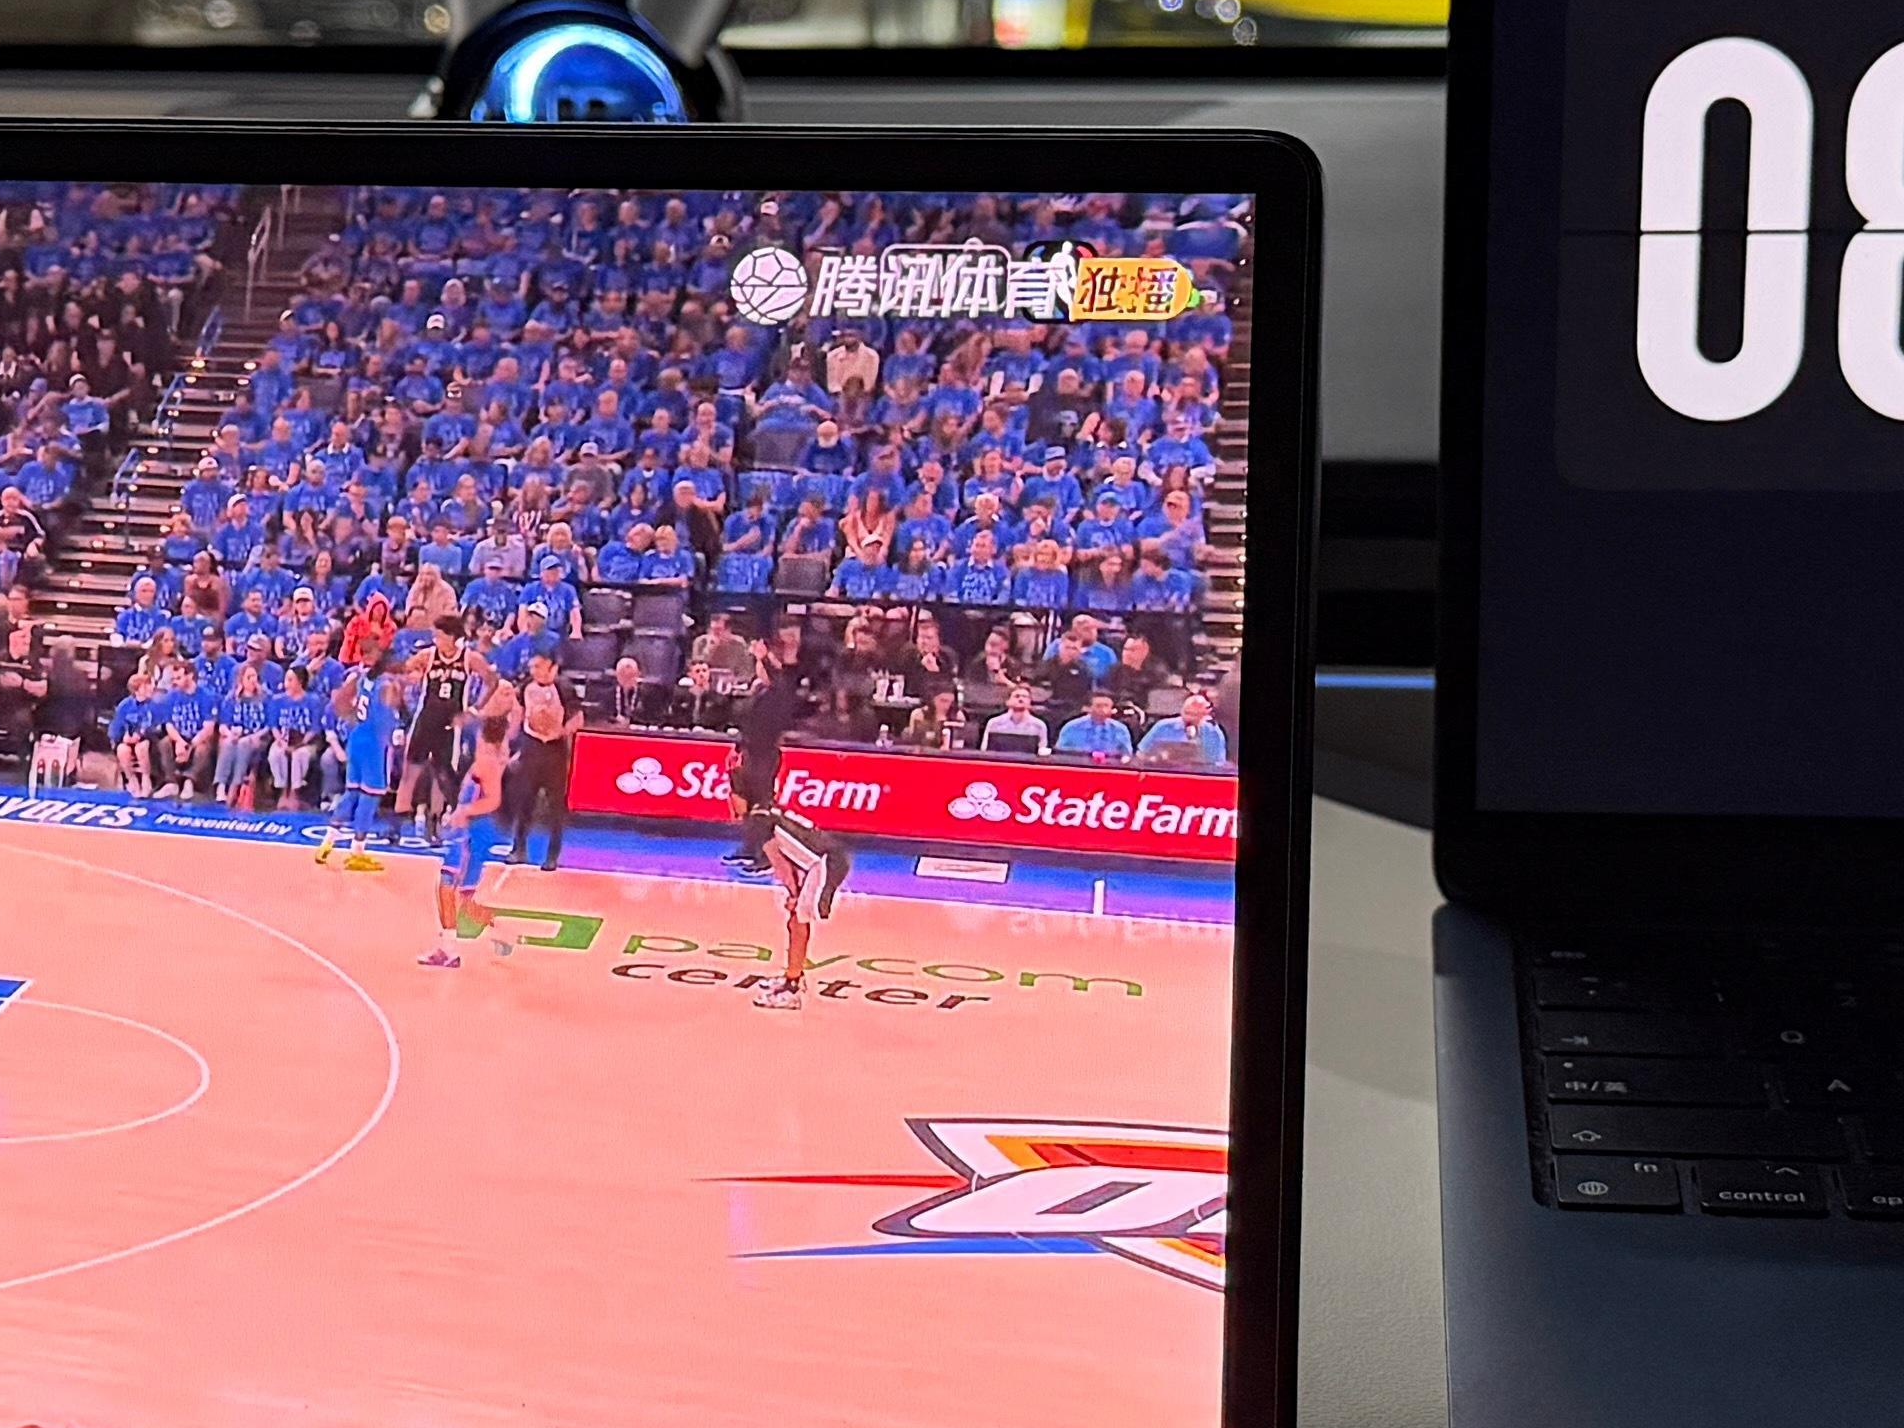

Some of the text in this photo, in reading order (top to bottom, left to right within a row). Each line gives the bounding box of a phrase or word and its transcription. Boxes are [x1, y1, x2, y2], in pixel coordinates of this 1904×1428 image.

[809, 254, 1058, 320] 腾讯体育
[154, 812, 266, 834] Presented
[263, 820, 293, 836] by
[1632, 1161, 1659, 1174] fn
[1717, 1189, 1807, 1204] control
